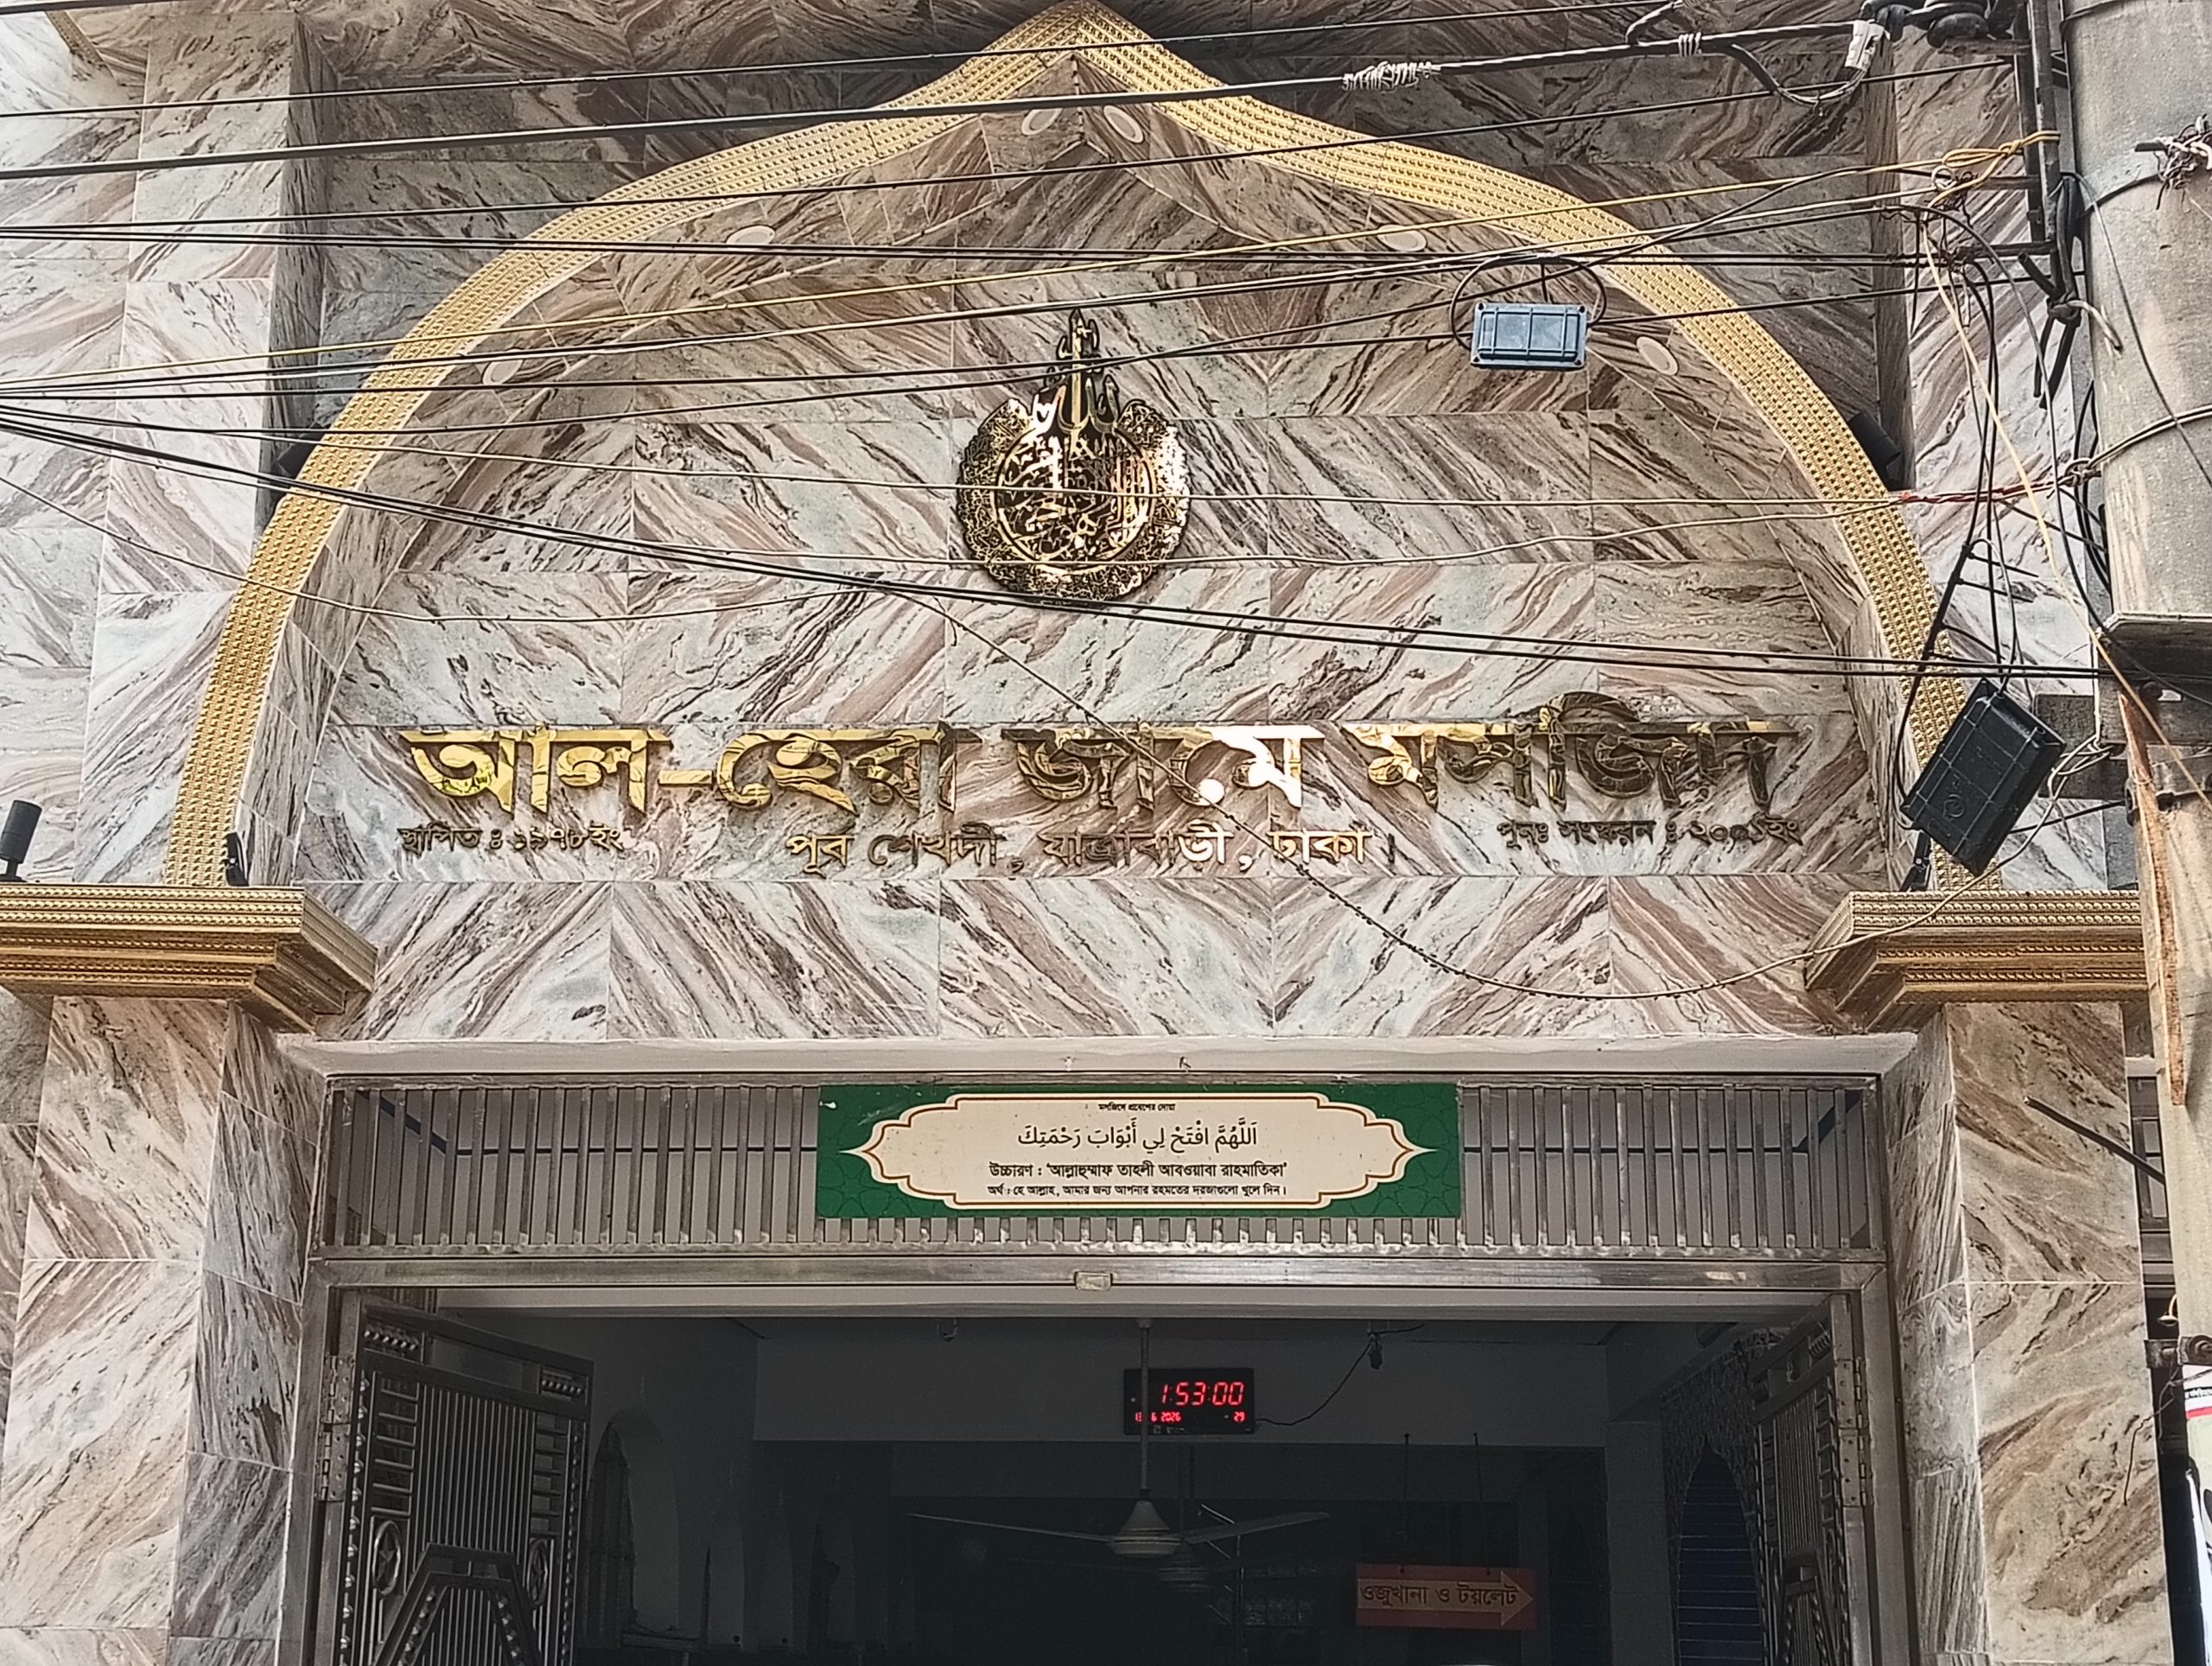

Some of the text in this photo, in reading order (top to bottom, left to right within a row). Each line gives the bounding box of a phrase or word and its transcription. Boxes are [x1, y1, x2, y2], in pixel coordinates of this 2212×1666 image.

[1000, 720, 1325, 811] জামে
[1339, 690, 1800, 811] মসজিদ
[397, 821, 483, 858] স্থাপিত
[1092, 1186, 1112, 1196] জন্য
[1114, 1185, 1149, 1195] আপনার
[1151, 1185, 1190, 1196] রহমতের
[1435, 1587, 1451, 1604] ও
